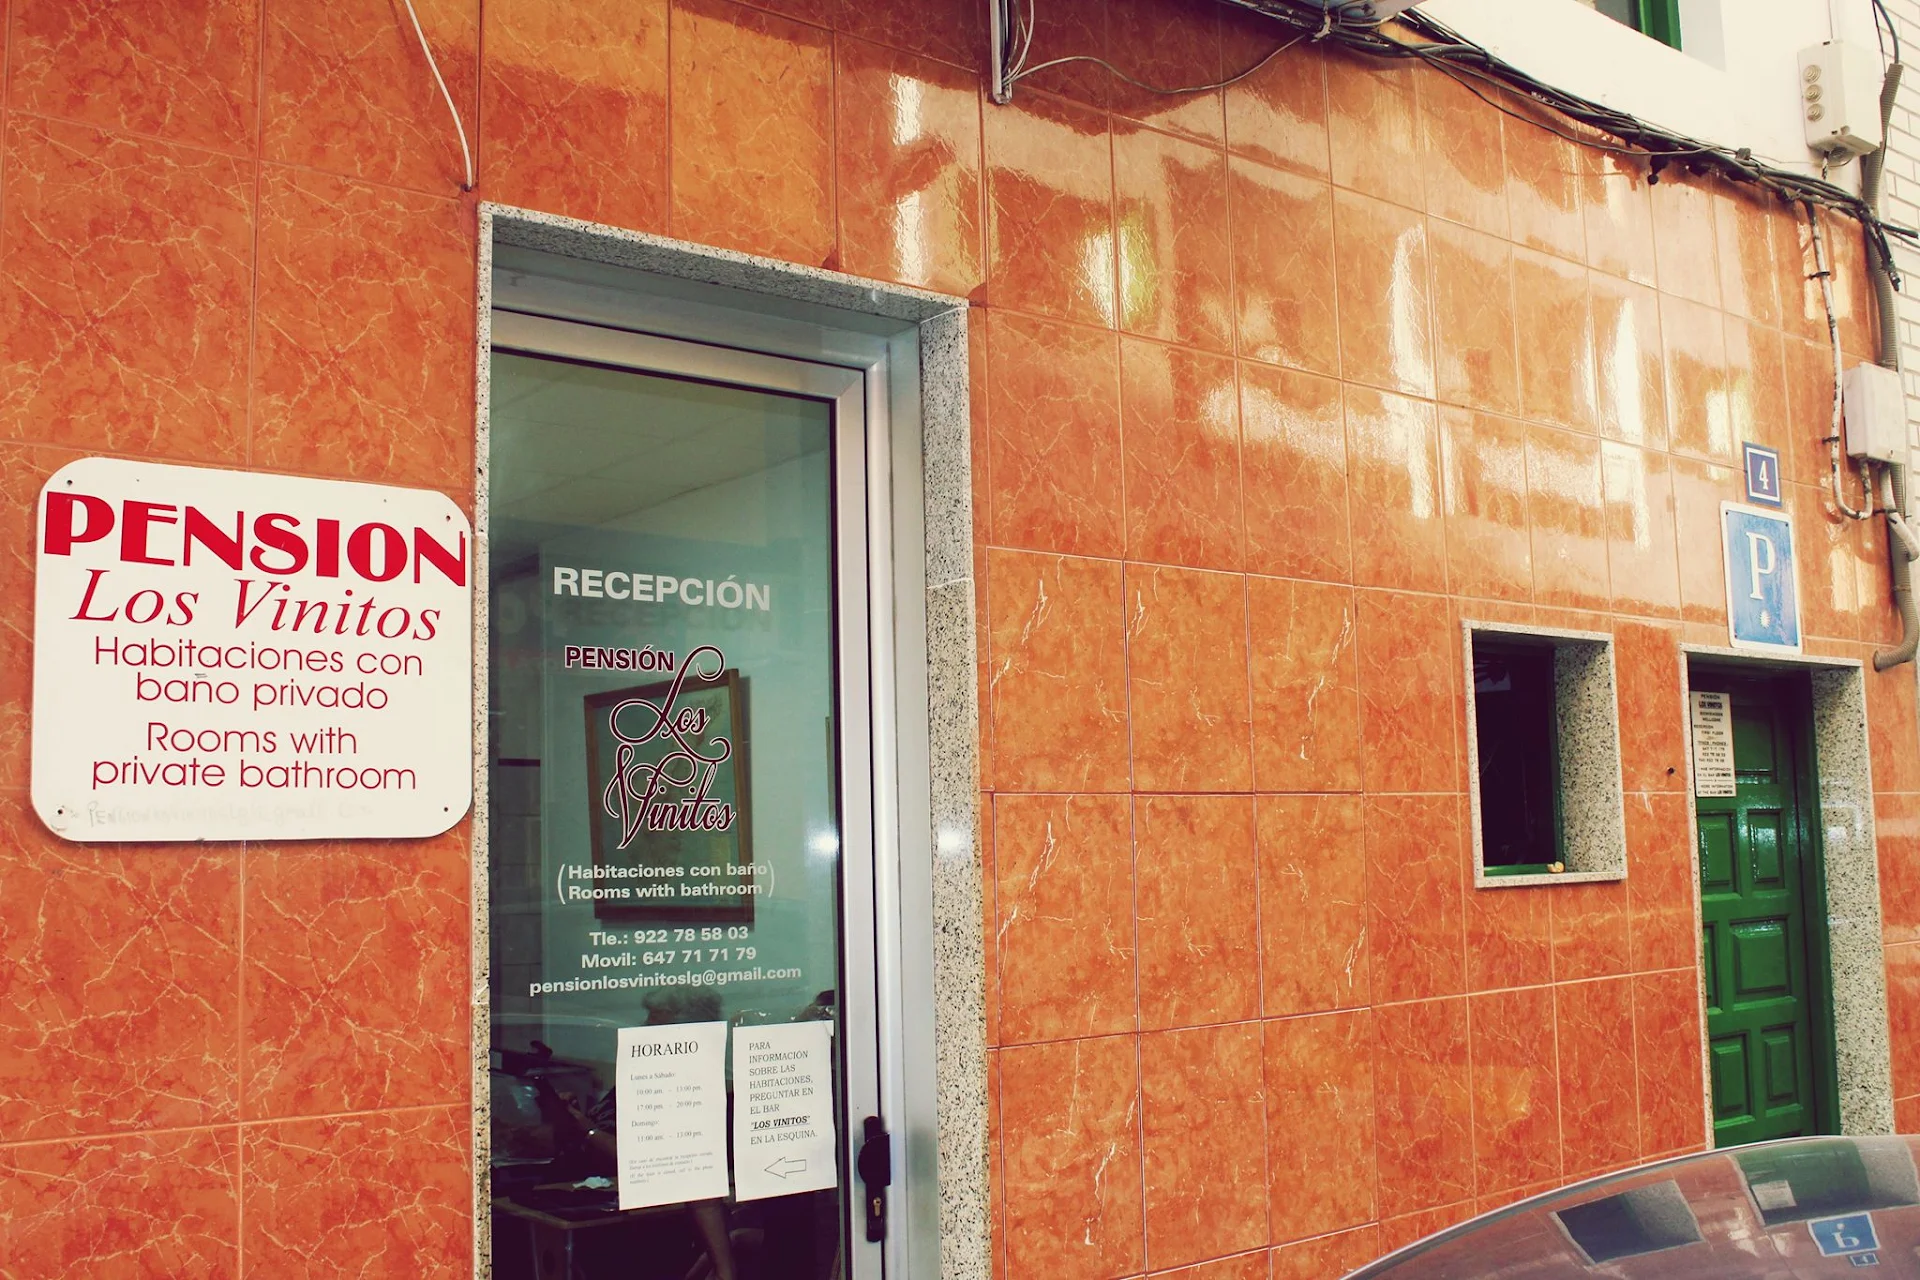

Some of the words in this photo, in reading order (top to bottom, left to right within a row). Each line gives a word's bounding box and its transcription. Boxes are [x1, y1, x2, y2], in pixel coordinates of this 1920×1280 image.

[1759, 460, 1769, 490] 4
[44, 491, 466, 587] PENSION
[1746, 532, 1776, 600] P
[553, 566, 770, 611] RECEPCIÓN
[69, 568, 199, 626] Los
[233, 578, 441, 641] Vinitos
[95, 636, 344, 674] Habitaciones
[357, 651, 423, 676] con
[564, 644, 675, 673] PENSIÓN
[136, 672, 240, 705] baño
[253, 679, 389, 711] privado
[609, 645, 732, 764] Los
[147, 722, 277, 754] Rooms
[290, 727, 357, 754] with
[92, 755, 226, 790] private
[240, 759, 416, 790] bathroom
[603, 742, 736, 850] Vinitos
[567, 864, 685, 880] Habitaciones
[689, 865, 721, 877] con
[726, 862, 768, 877] baño
[568, 884, 631, 900] Rooms
[635, 882, 675, 898] with
[680, 882, 763, 897] bathroom
[589, 931, 628, 946] Tle.:
[634, 930, 668, 945] 922
[674, 928, 696, 942] 78
[701, 927, 723, 941] 58
[727, 926, 749, 940] 03
[581, 953, 636, 969] Movil:
[642, 950, 675, 966] 647
[682, 949, 701, 964] 71
[709, 948, 729, 962] 71
[736, 947, 757, 961] 79
[529, 967, 802, 997] pensionlosvinitoslg@gmail.com
[631, 1040, 699, 1058] HORARIO
[749, 1041, 771, 1050] PARA
[749, 1050, 809, 1063] INFORMACIÓN
[630, 1073, 648, 1081] Lunes
[749, 1066, 778, 1076] SOBRE
[780, 1064, 796, 1073] LAS
[750, 1090, 800, 1102] PREGUNTAR
[802, 1087, 814, 1096] EN
[750, 1106, 761, 1115] EL
[763, 1104, 780, 1113] BAR
[750, 1136, 763, 1145] EN
[765, 1135, 775, 1143] LA
[777, 1130, 818, 1142] ESQUINA.
